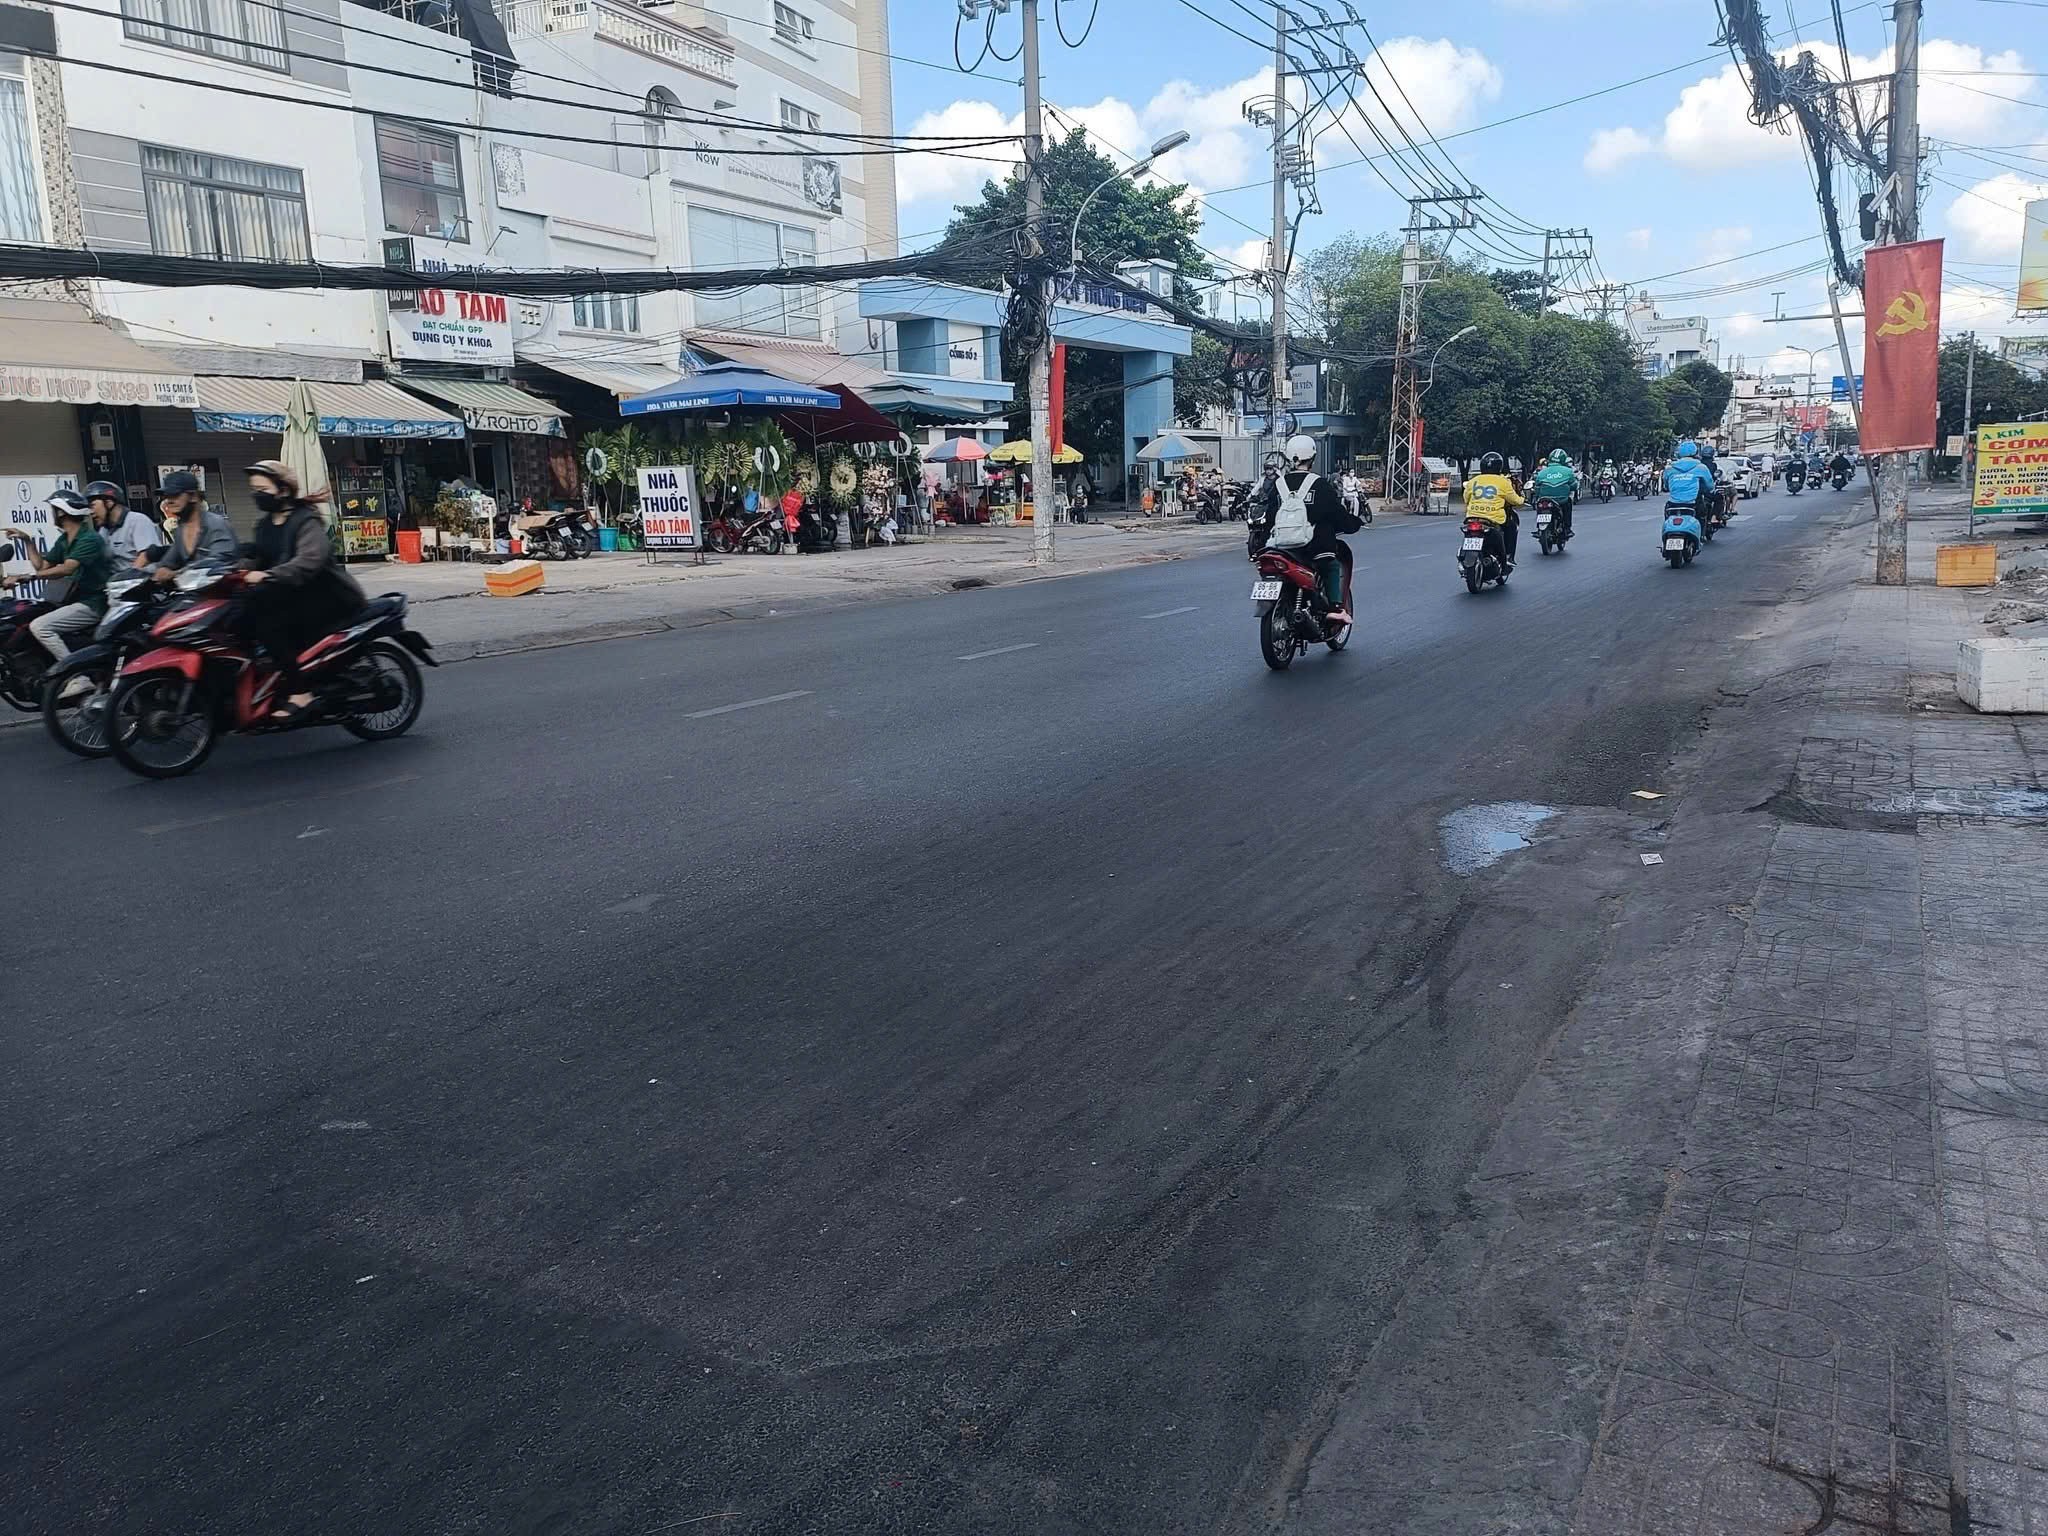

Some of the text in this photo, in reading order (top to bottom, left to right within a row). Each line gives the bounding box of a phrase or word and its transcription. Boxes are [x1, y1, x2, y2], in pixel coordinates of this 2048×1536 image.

[695, 152, 719, 166] NOW
[389, 243, 405, 260] NHÀ
[412, 331, 493, 348] DỤNG CỤ Y KHOA
[97, 379, 150, 401] SK39
[153, 383, 171, 393] 1115
[172, 383, 187, 393] CMT
[1997, 428, 2024, 439] KIM
[647, 469, 678, 489] NHÀ
[1473, 481, 1497, 499] be
[2003, 485, 2031, 496] 30K
[642, 491, 688, 512] THUỐC
[12, 504, 48, 524] BẢO ÂN
[645, 514, 691, 535] BẢO TÂM
